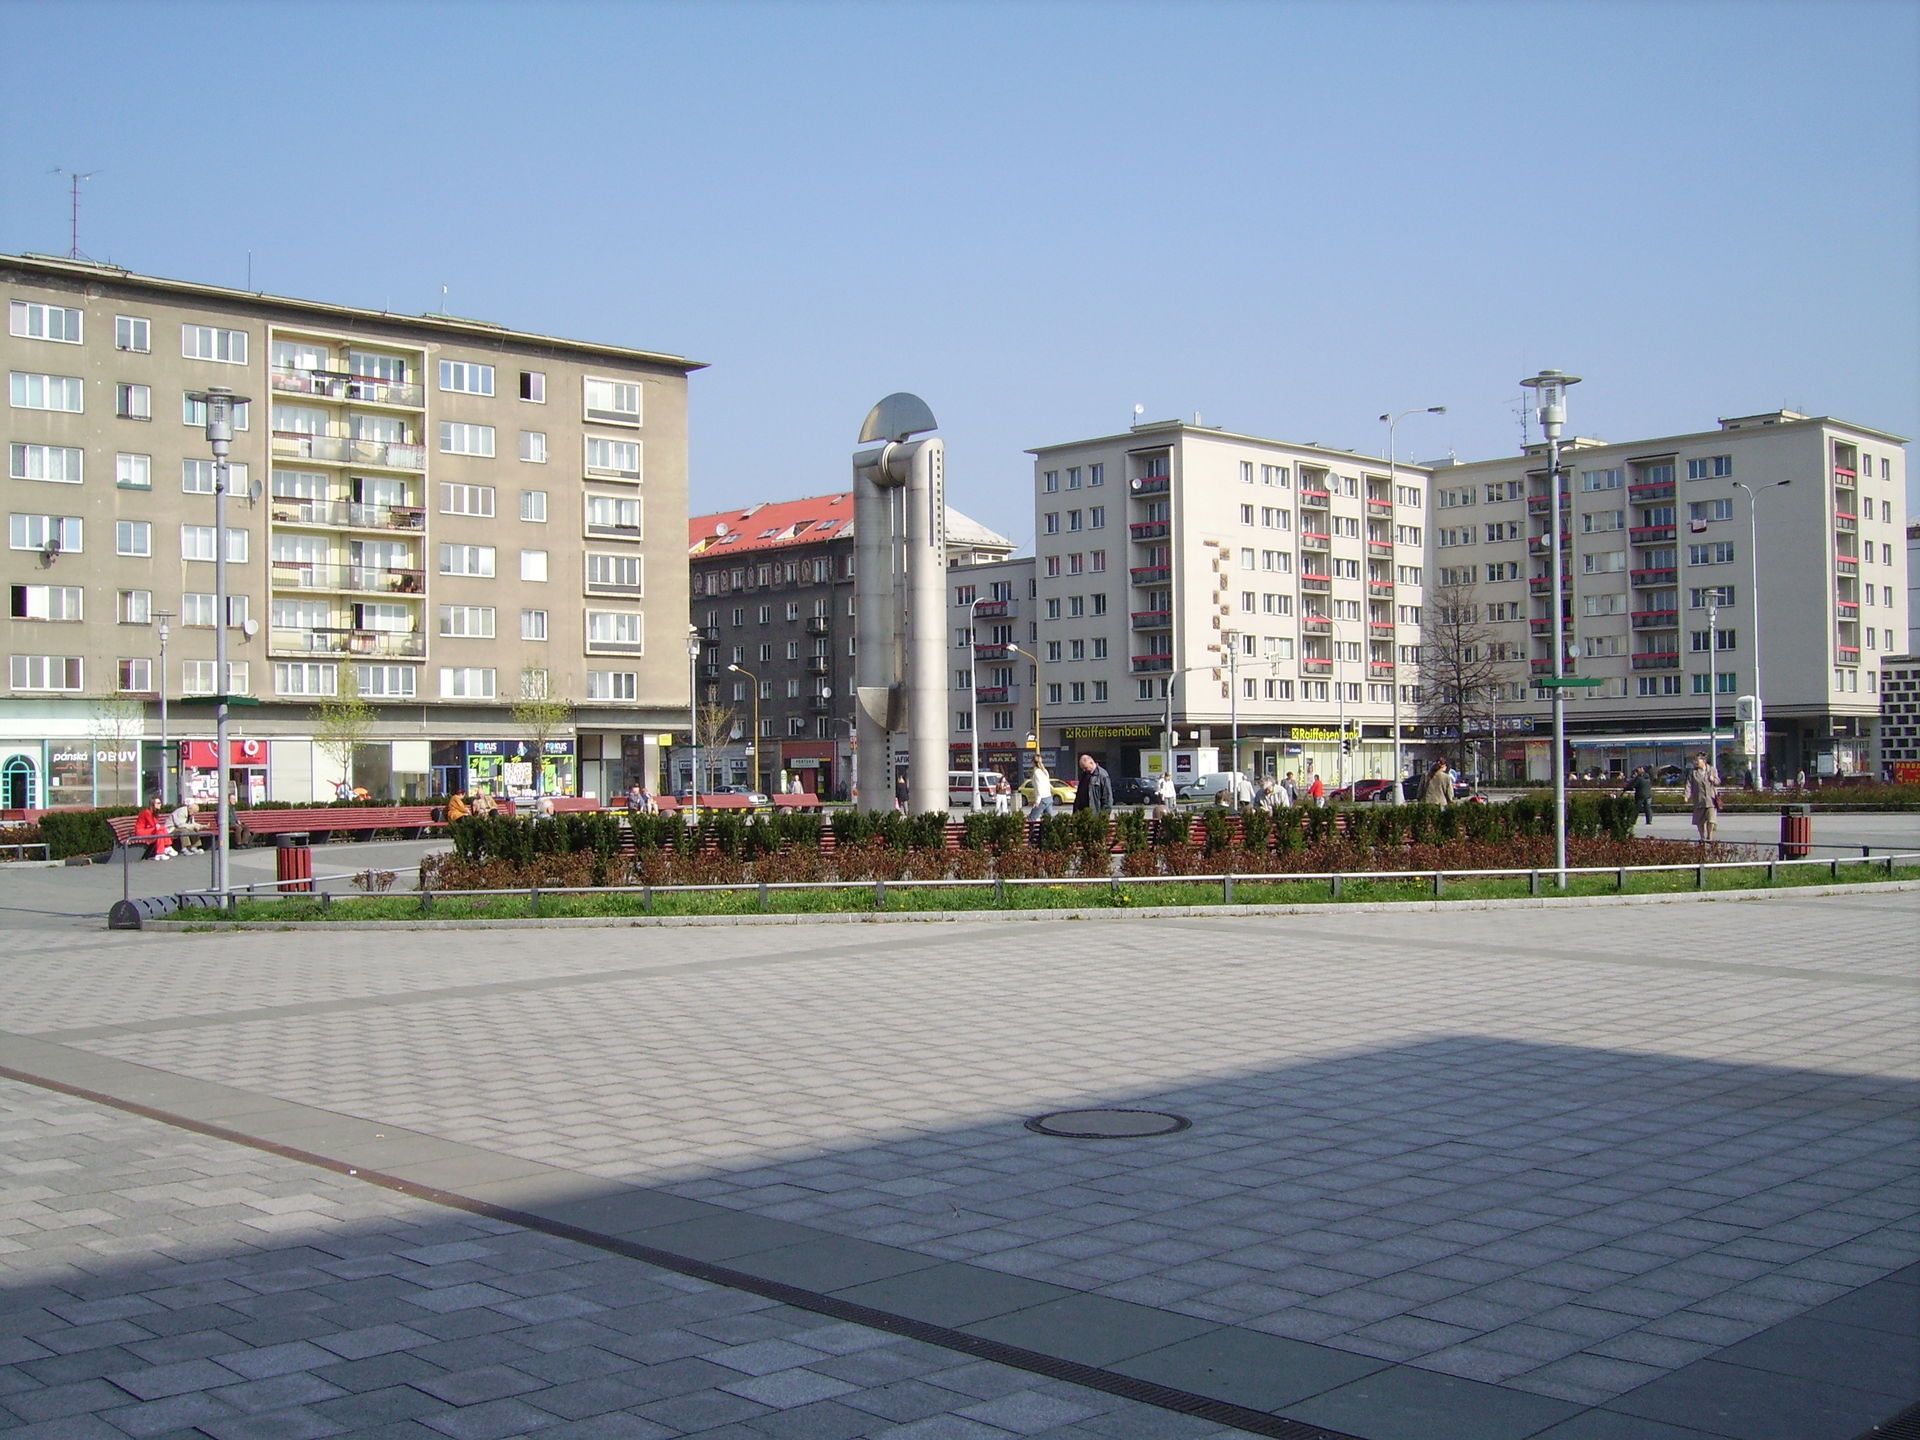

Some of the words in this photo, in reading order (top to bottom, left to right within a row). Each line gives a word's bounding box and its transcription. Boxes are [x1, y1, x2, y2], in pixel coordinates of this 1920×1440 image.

[1075, 725, 1151, 739] Raiffeisenbank
[1300, 728, 1359, 740] Raiffeisenank
[474, 742, 497, 751] FOKUS
[545, 742, 567, 751] FOKUS
[53, 751, 88, 763] pánská
